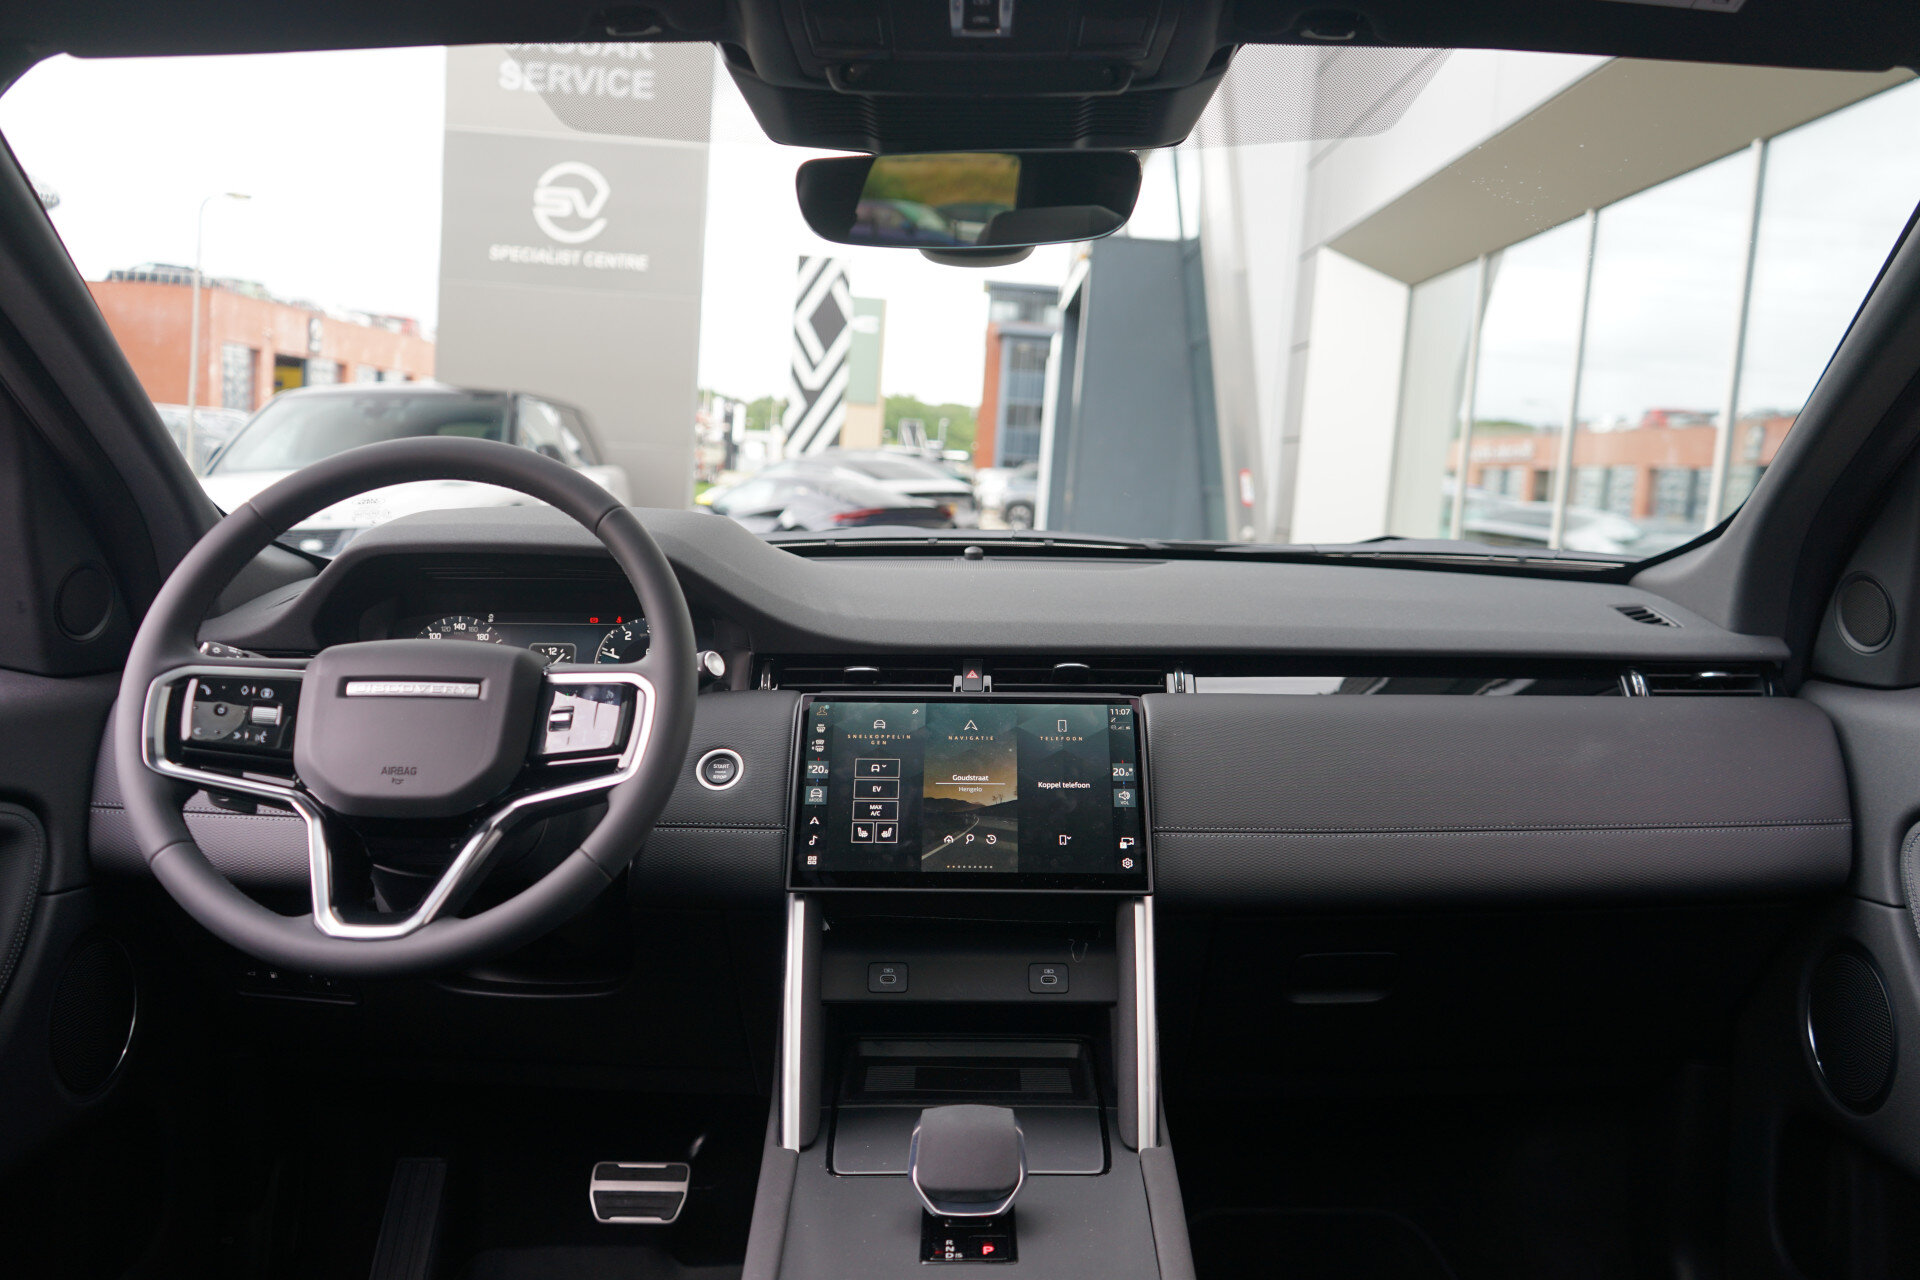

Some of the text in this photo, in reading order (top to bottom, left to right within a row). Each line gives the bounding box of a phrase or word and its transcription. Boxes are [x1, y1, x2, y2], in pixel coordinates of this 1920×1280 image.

[499, 59, 654, 100] SERVICE
[489, 244, 649, 271] SPECIALIST CENTRE
[453, 623, 466, 631] 140
[625, 631, 631, 641] 2
[548, 647, 557, 656] 12
[1110, 708, 1131, 716] 11:07
[381, 766, 417, 776] AIRBAG
[952, 774, 989, 782] Goudstraat
[872, 785, 882, 793] EV
[1038, 781, 1091, 790] Koppel telefoon
[982, 1245, 994, 1255] P
